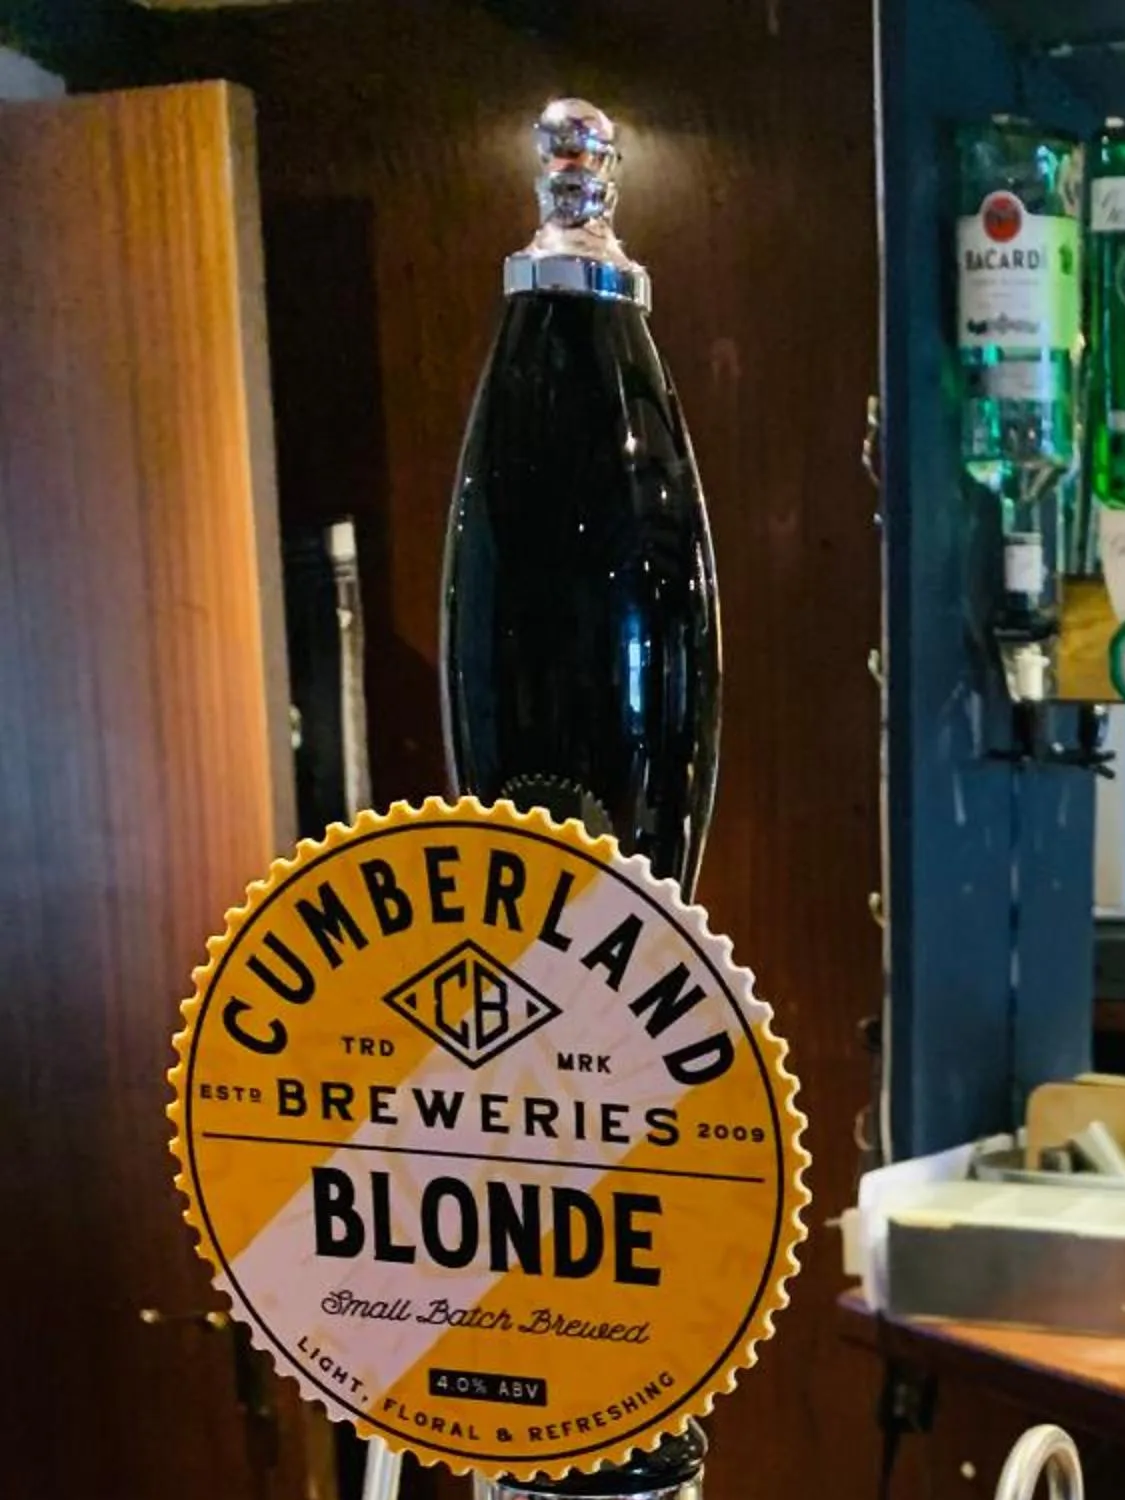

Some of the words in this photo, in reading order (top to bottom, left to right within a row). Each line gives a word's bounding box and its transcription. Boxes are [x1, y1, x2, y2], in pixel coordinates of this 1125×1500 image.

[222, 846, 736, 1086] CUMBERLAND
[341, 1036, 395, 1057] TRD
[557, 1052, 611, 1075] MRK
[277, 1078, 681, 1147] BREWERIES
[697, 1122, 765, 1144] 2009
[311, 1166, 663, 1286] BLONDE
[321, 1290, 412, 1323] Small
[417, 1299, 513, 1332] Batch
[518, 1308, 650, 1345] Brewed
[297, 1336, 369, 1402] LIGHT,
[383, 1398, 480, 1441] FLORAL
[497, 1428, 513, 1442] &
[528, 1373, 676, 1442] REFRESHING
[436, 1375, 488, 1395] 4.0%
[499, 1382, 539, 1400] ABV
